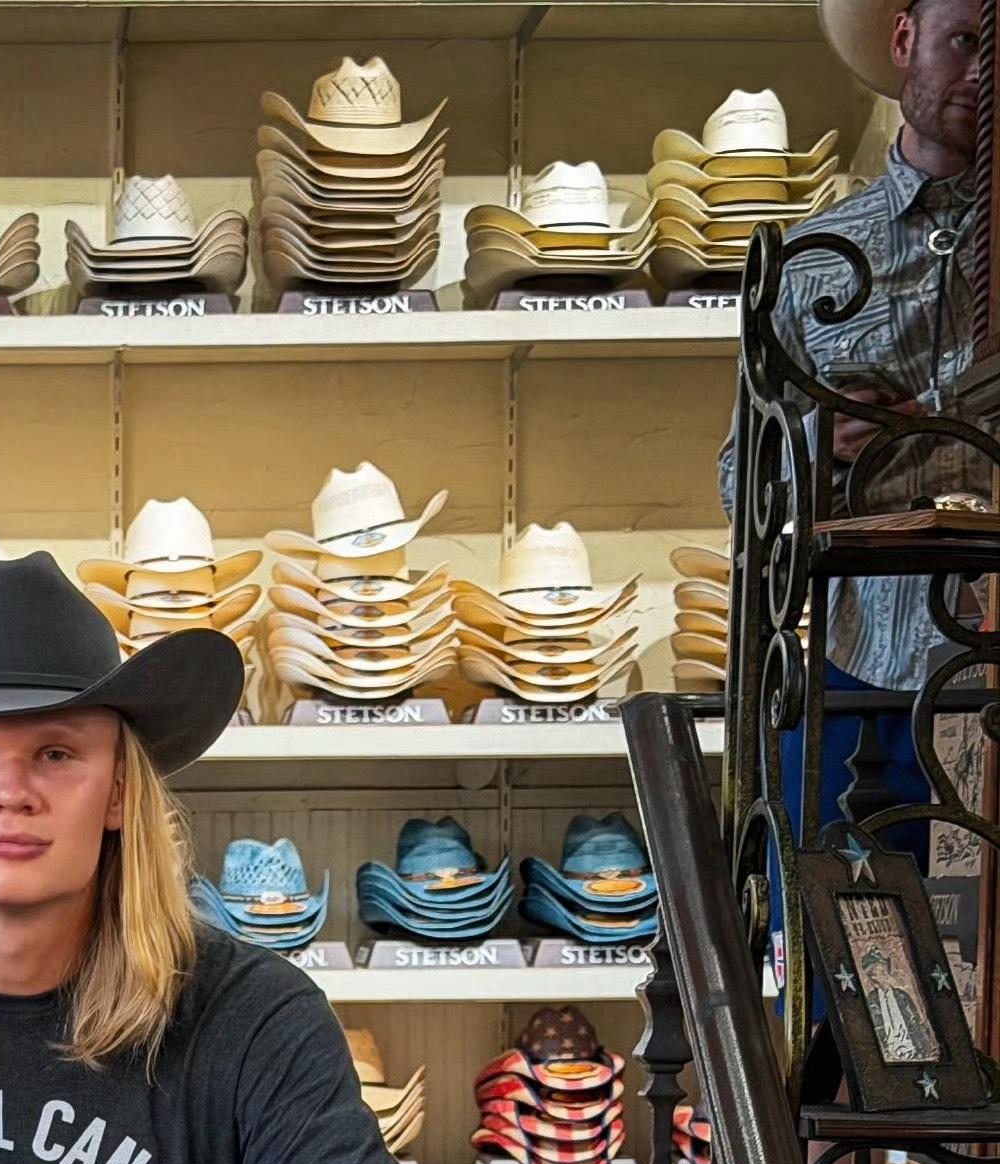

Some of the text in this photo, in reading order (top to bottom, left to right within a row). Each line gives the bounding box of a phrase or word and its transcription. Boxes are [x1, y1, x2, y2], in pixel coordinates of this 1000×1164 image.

[100, 300, 206, 317] STETSON
[303, 297, 412, 315] STETSON
[519, 295, 625, 312] STETSON
[688, 295, 741, 309] STET
[317, 704, 423, 724] STETSON
[501, 704, 610, 723] STETSON
[395, 947, 500, 966] STETSON
